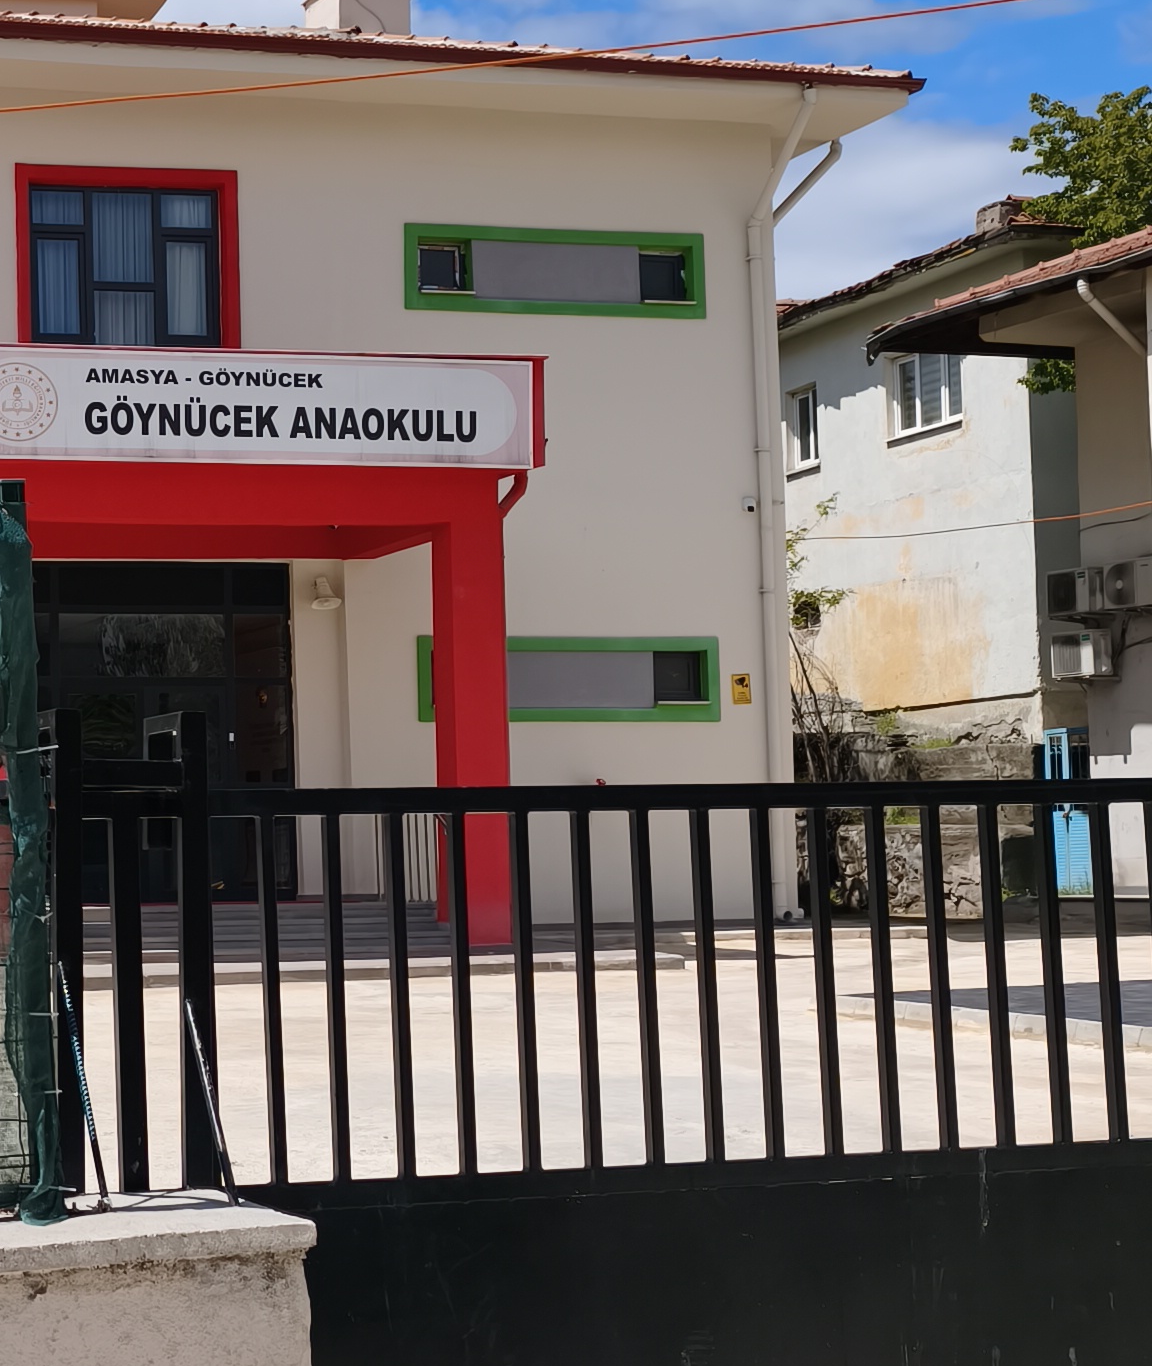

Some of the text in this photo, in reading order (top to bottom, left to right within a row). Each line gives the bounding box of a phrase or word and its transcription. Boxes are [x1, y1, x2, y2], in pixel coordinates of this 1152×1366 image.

[85, 368, 179, 386] AMASYA
[198, 369, 323, 389] GÖYNÜCEK
[84, 395, 477, 443] GÖYNÜCEK ANAOKULU
